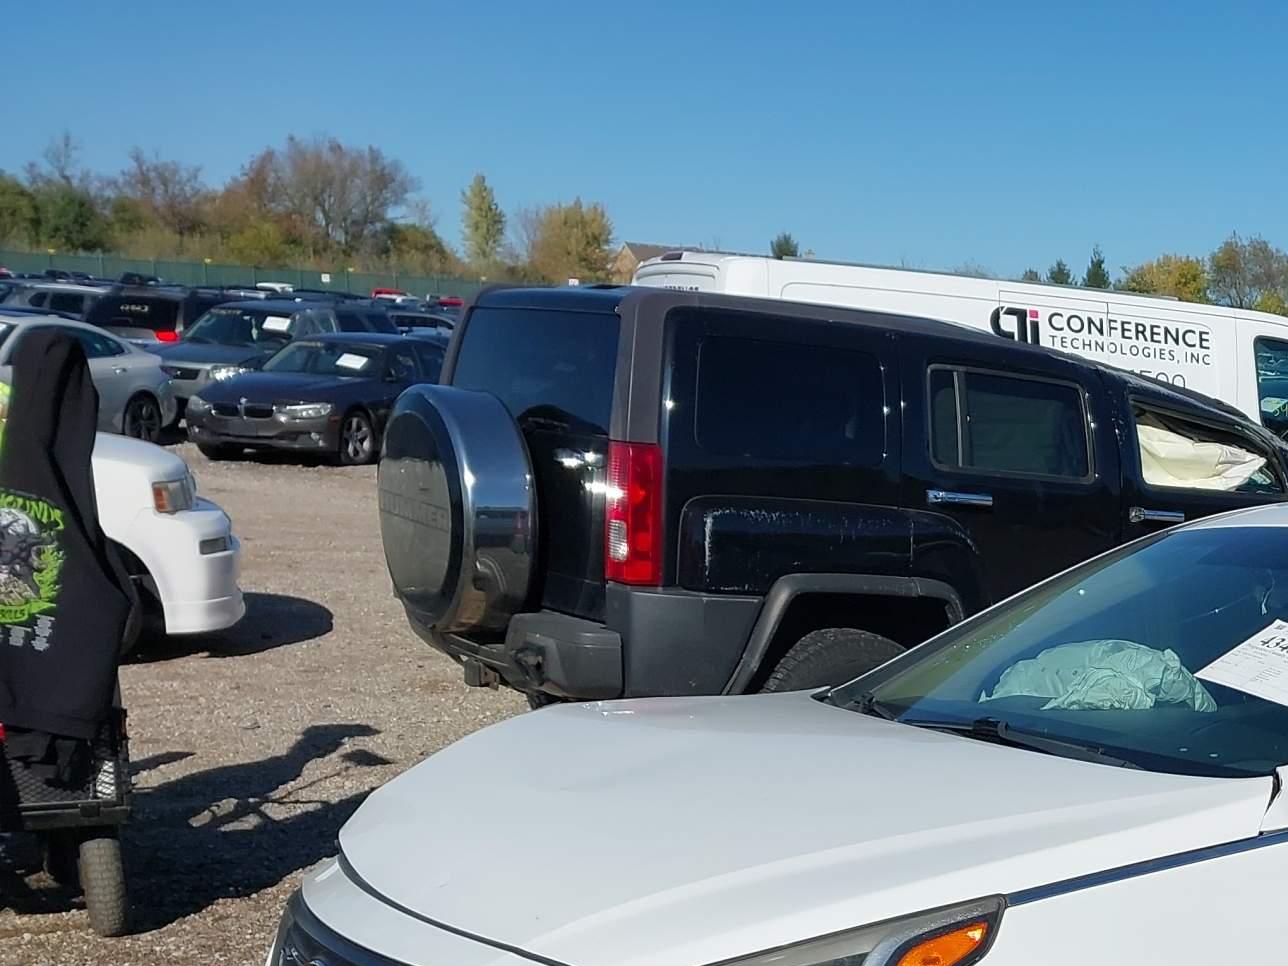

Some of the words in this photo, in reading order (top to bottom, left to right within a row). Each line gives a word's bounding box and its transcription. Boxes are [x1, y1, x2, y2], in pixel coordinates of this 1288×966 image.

[1048, 312, 1211, 350] CONFERENCE
[1048, 335, 1181, 364] TECHNOLOGIES,
[1185, 351, 1211, 366] INC
